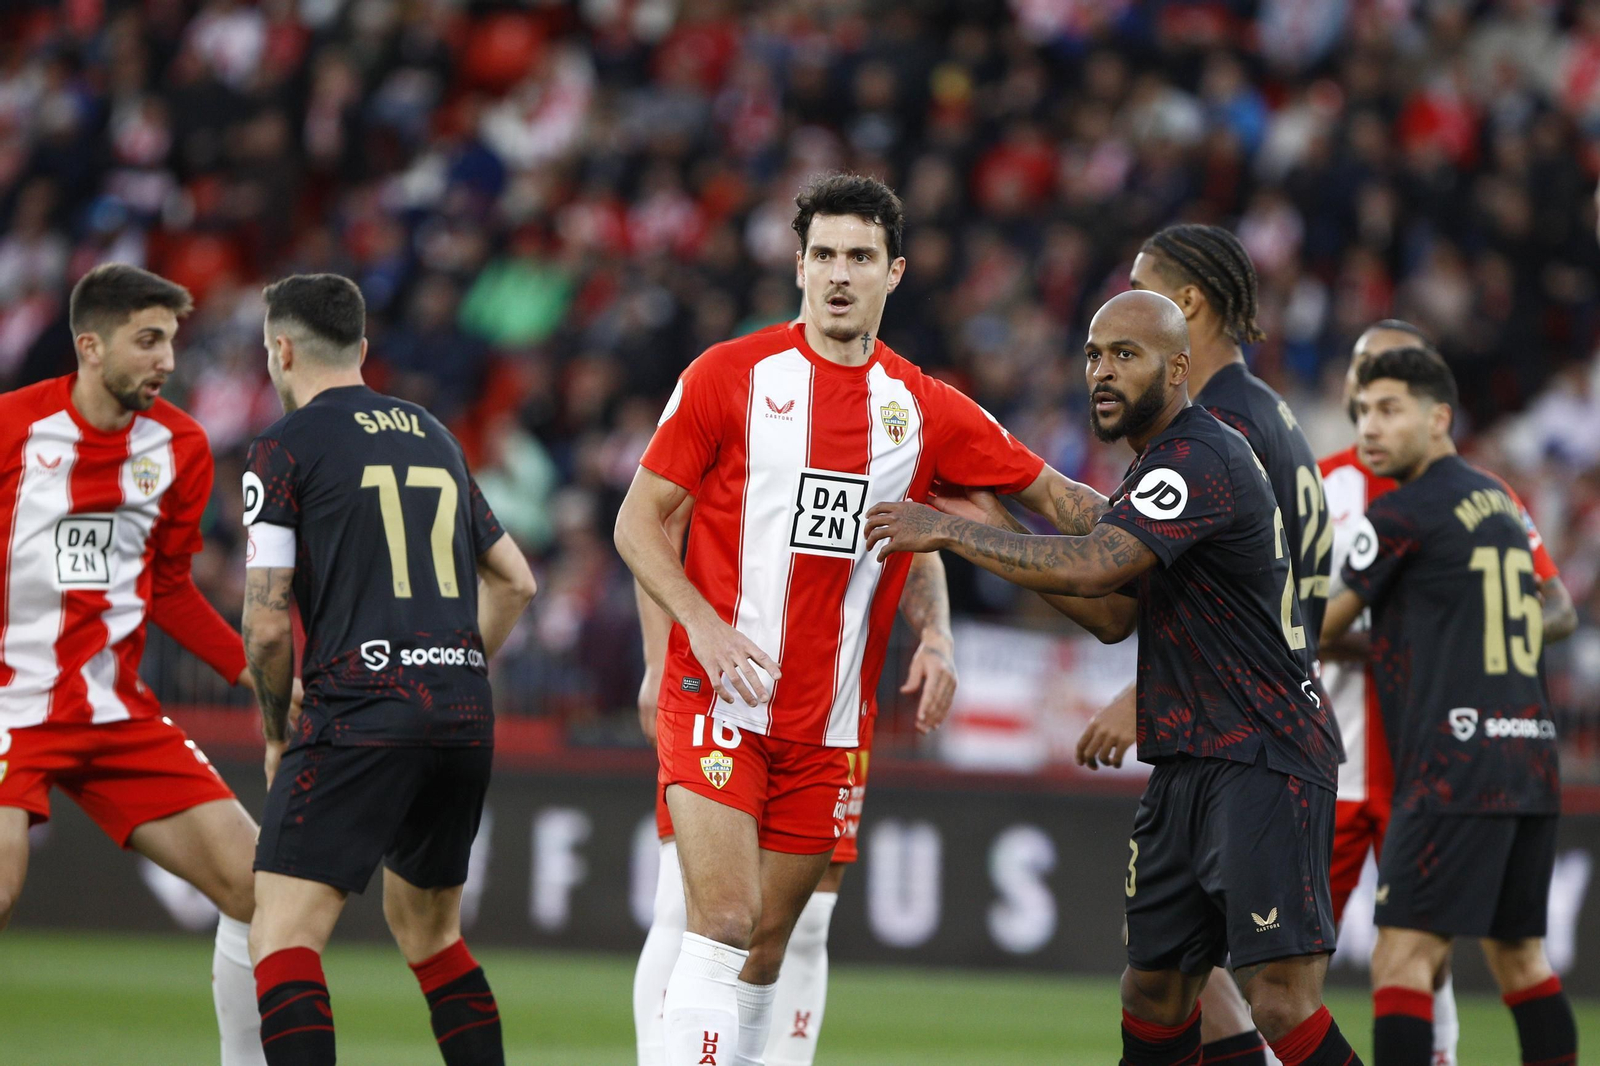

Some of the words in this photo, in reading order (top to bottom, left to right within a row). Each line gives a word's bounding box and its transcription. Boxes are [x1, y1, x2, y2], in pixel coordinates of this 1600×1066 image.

[765, 413, 793, 422] CASTORE
[244, 485, 258, 513] D
[1135, 480, 1182, 511] JD
[360, 464, 459, 599] 17
[1469, 546, 1543, 677] 15
[692, 713, 742, 749] 16
[1256, 923, 1280, 933] CASTORE
[698, 1031, 719, 1066] UDA
